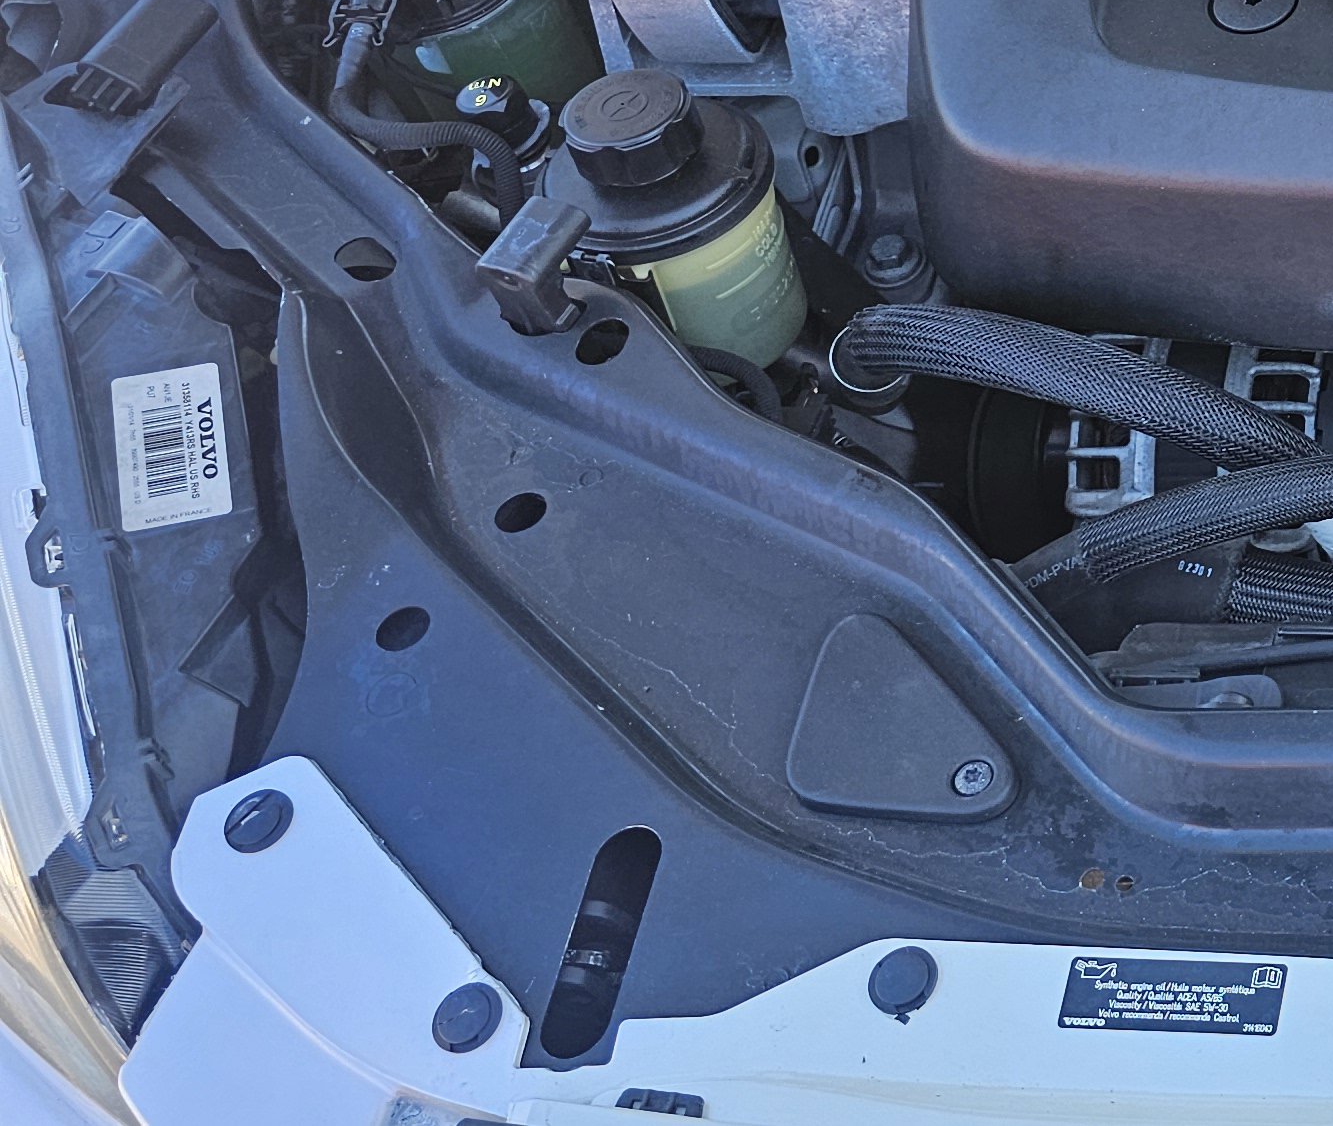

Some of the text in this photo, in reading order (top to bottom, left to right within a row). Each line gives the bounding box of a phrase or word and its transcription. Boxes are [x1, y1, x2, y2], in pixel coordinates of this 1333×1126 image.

[197, 397, 219, 479] VOLVO
[188, 451, 197, 468] HAL
[190, 469, 199, 481] US
[191, 482, 200, 499] RHS
[1185, 1002, 1201, 1012] SAE
[1203, 1003, 1229, 1013] 5W-30
[1063, 1016, 1106, 1027] VOLVO
[1098, 1008, 1120, 1018] Volvo
[1213, 1012, 1240, 1023] Castrol
